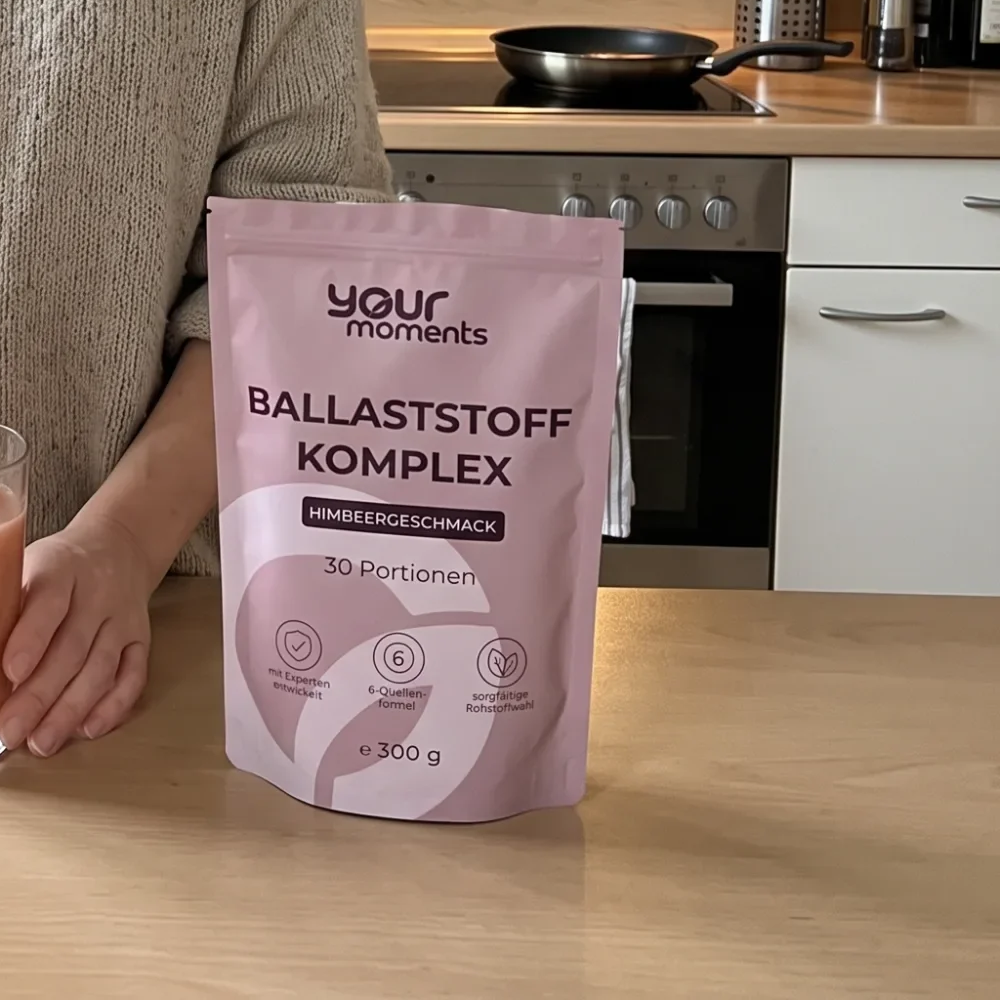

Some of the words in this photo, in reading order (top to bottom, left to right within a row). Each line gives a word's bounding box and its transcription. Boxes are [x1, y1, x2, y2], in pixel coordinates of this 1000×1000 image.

[327, 283, 449, 322] your
[346, 319, 488, 345] moments
[248, 385, 573, 438] BALLASTSTOFF
[298, 441, 512, 487] KOMPLEX
[309, 506, 497, 534] HIMBEERGESCHMACK
[324, 556, 353, 576] 30
[360, 560, 476, 586] Portionen
[393, 650, 404, 666] 6
[268, 668, 283, 679] mit
[285, 671, 330, 689] Experten
[368, 685, 427, 699] 6-Quellen-
[378, 698, 416, 711] formel
[377, 741, 420, 761] 300
[427, 750, 441, 767] g
